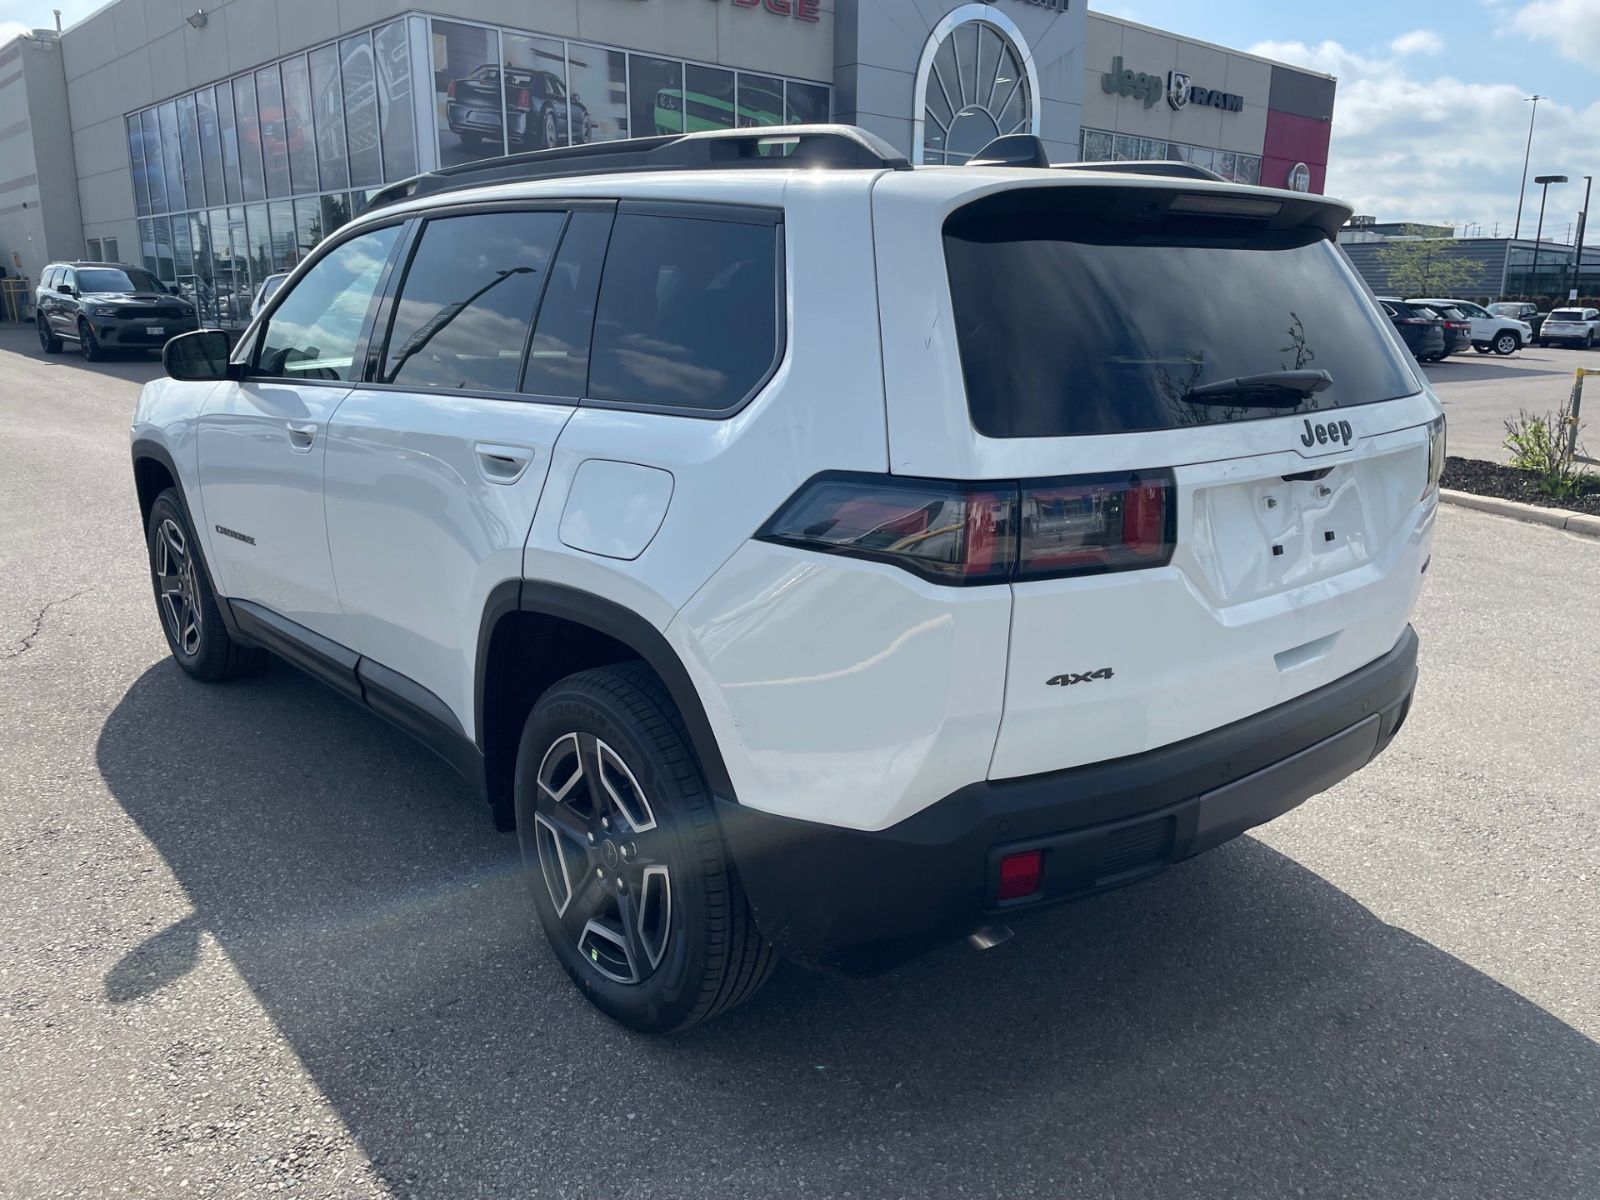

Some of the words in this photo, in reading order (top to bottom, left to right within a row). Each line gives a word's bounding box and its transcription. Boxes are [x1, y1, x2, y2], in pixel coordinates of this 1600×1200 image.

[1101, 56, 1163, 110] Jeep
[1190, 86, 1244, 112] RAM
[1300, 419, 1353, 447] Jeep
[1046, 667, 1114, 686] 4x4
